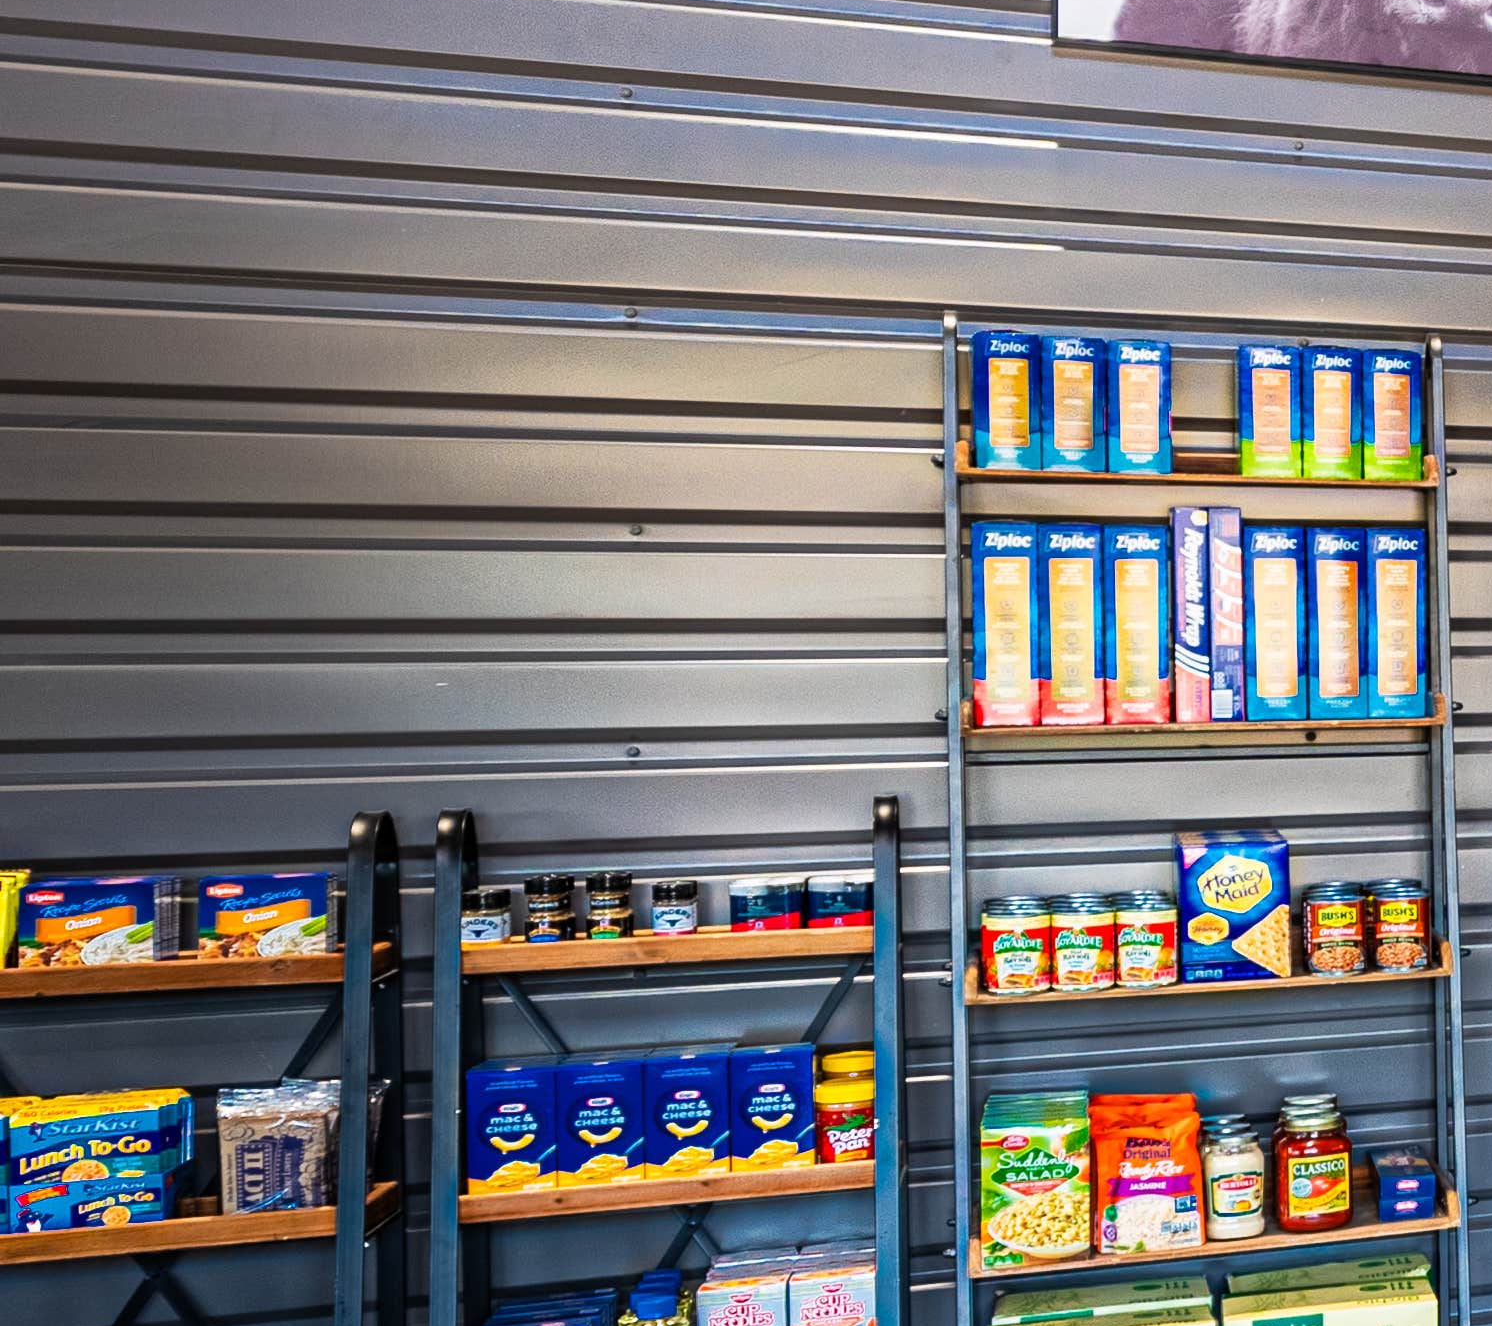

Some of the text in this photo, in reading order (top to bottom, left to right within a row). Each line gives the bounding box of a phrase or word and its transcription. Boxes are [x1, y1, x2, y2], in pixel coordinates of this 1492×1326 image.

[990, 339, 1030, 354] Ziploc
[1055, 342, 1094, 358] Ziploc
[1120, 346, 1161, 362] Ziploc
[1253, 352, 1291, 366] Ziploc
[1315, 354, 1352, 369] Ziploc
[1375, 357, 1411, 371] Ziploc
[985, 533, 1033, 550] Ziploc
[1050, 534, 1096, 551] Ziploc
[1116, 535, 1161, 553] Ziploc
[1254, 534, 1297, 553] Ziploc
[1318, 537, 1360, 554] Ziploc
[1377, 536, 1419, 553] Ziploc
[1180, 528, 1205, 647] Reynolds Wrap
[1202, 868, 1263, 893] Honey
[1215, 882, 1259, 904] Maid
[1321, 910, 1354, 921] BUSH'S
[1383, 906, 1415, 918] BUSH'S
[667, 1102, 696, 1110] mac
[752, 1095, 782, 1103] mac
[490, 1115, 521, 1124] mac
[579, 1109, 609, 1118] mac
[47, 1118, 143, 1136] StarKist
[826, 1128, 874, 1144] Peter
[832, 1137, 870, 1154] Pan
[19, 1136, 152, 1175] Lunch To-Go
[997, 1151, 1076, 1173] Suddenly
[1124, 1149, 1171, 1159] Original
[1293, 1159, 1345, 1175] CLASSICO
[1006, 1169, 1065, 1182] SALAD
[1129, 1181, 1167, 1191] JASMINE
